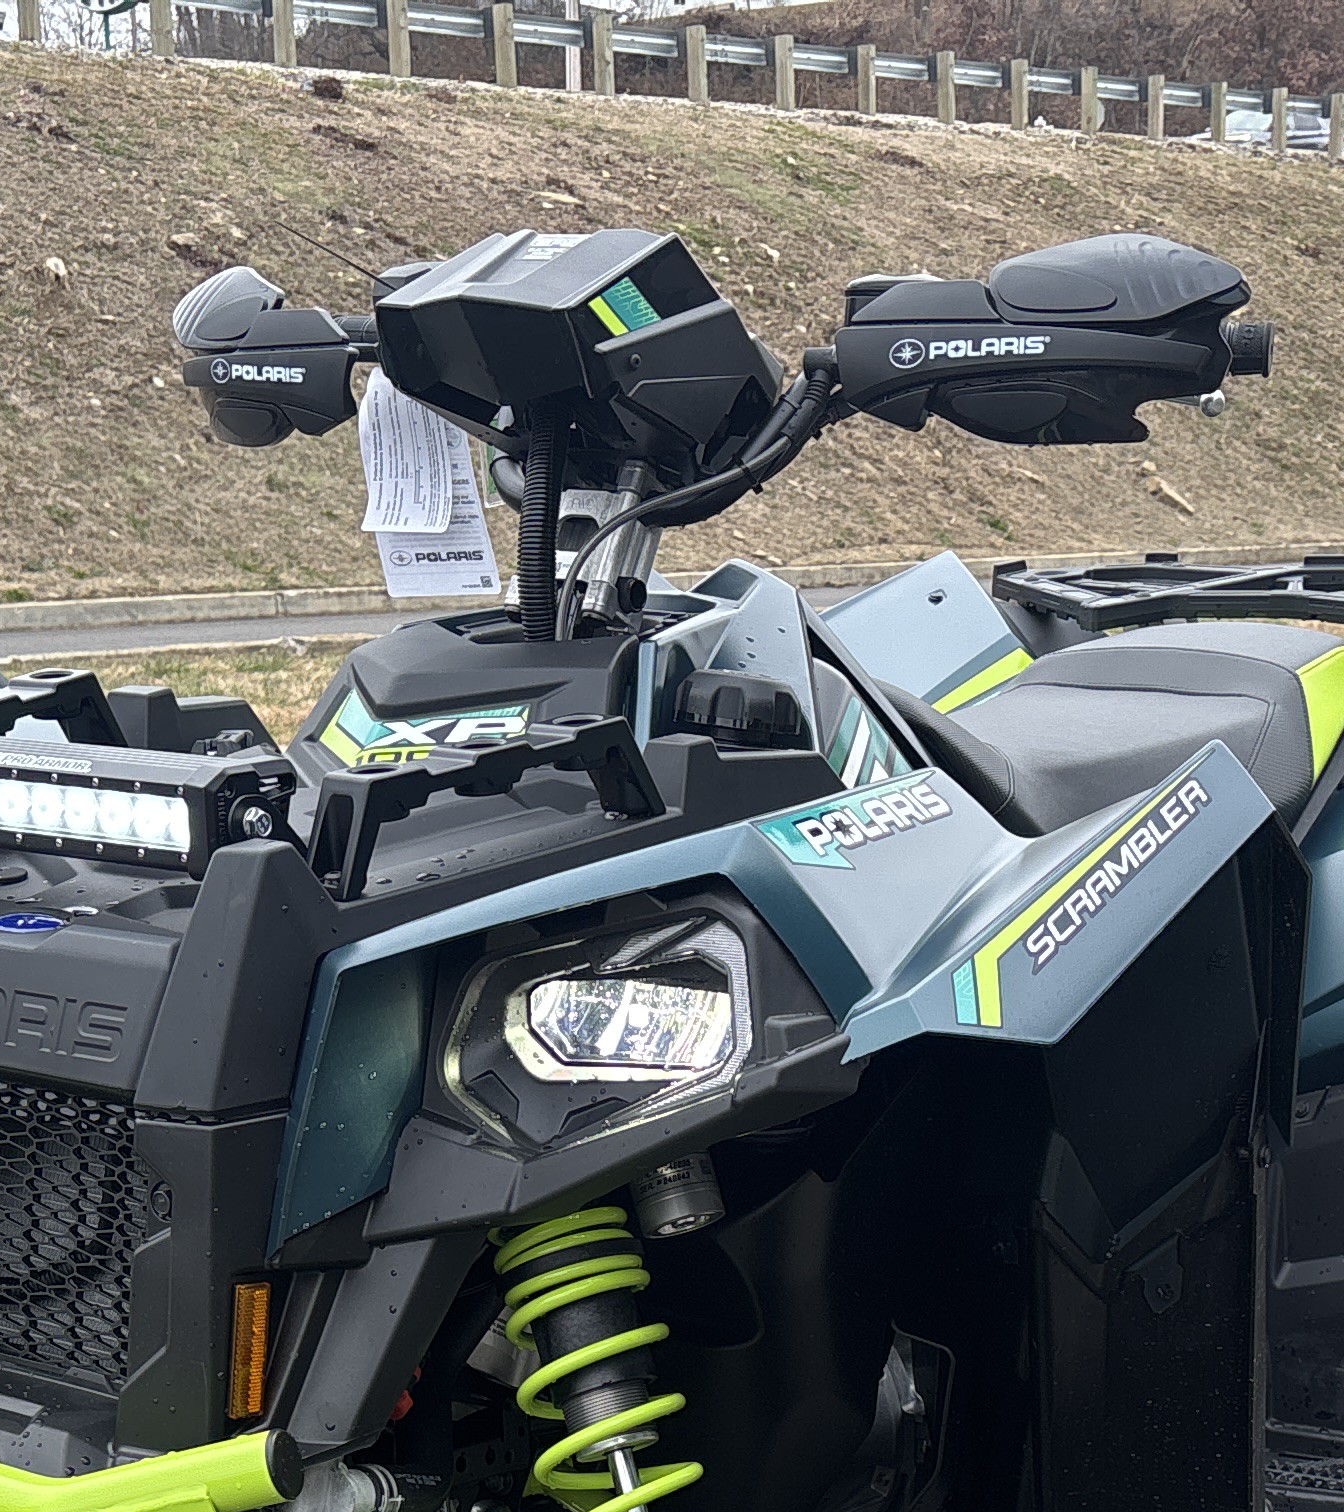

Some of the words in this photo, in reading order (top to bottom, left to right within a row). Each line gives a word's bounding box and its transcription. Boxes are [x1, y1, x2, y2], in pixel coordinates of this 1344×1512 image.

[928, 336, 1045, 360] POLARIS
[231, 363, 304, 384] POLARIS
[414, 550, 485, 564] POLARIS
[363, 715, 527, 750] XP
[797, 783, 954, 857] POLARIS
[1026, 777, 1212, 970] SCRAMBLER
